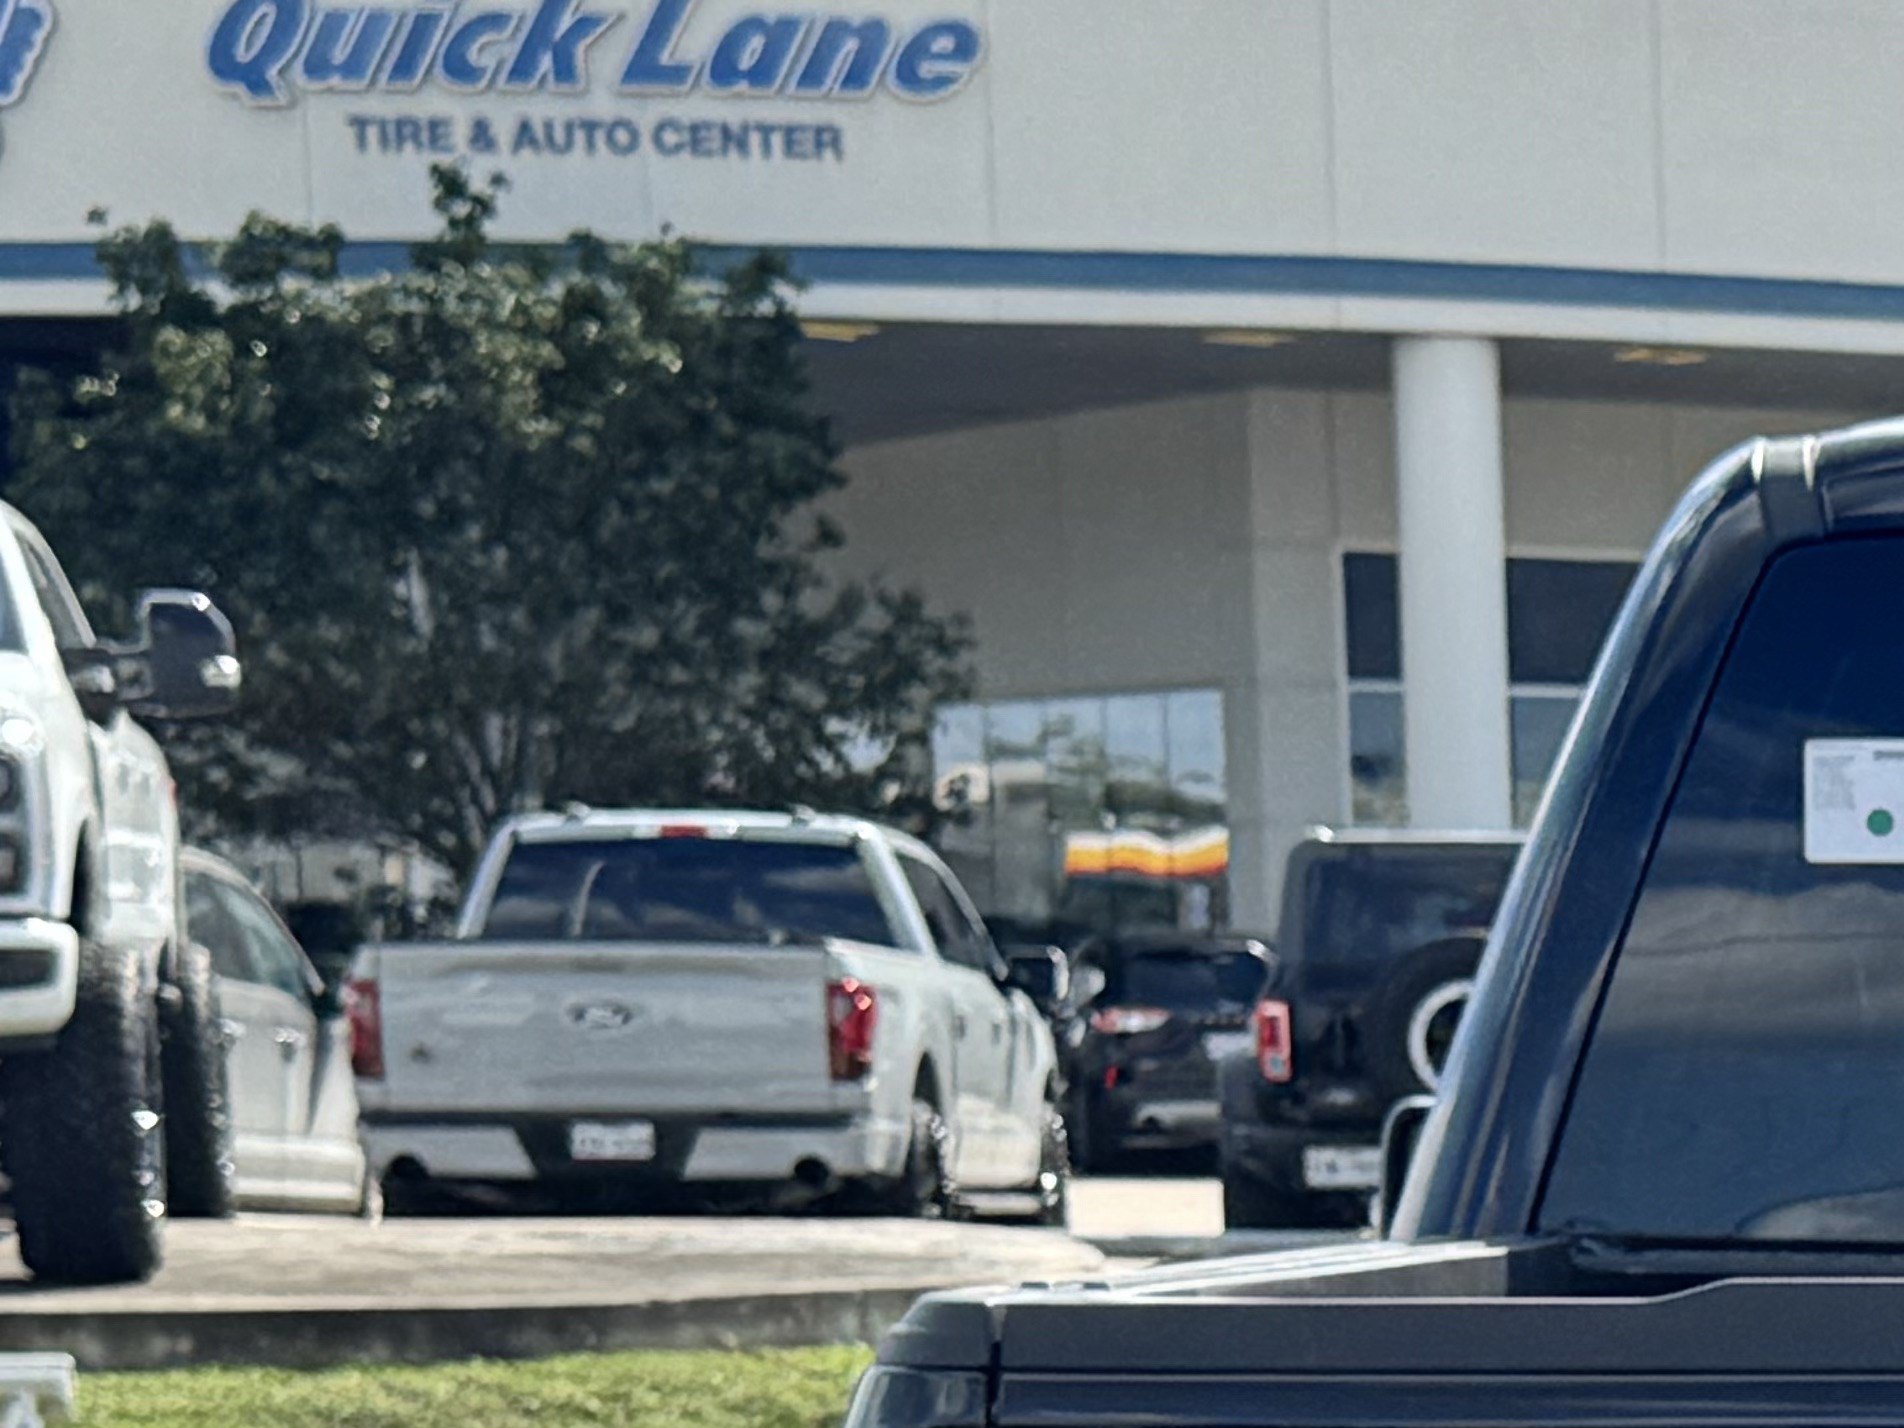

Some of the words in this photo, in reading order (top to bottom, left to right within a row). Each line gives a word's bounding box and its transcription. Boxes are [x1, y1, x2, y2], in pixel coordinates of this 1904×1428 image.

[198, 0, 612, 103] Quick
[618, 0, 982, 98] Lane
[348, 115, 455, 154] TIRE
[467, 117, 498, 152] &
[511, 116, 640, 157] AUTO
[651, 118, 845, 162] CENTER
